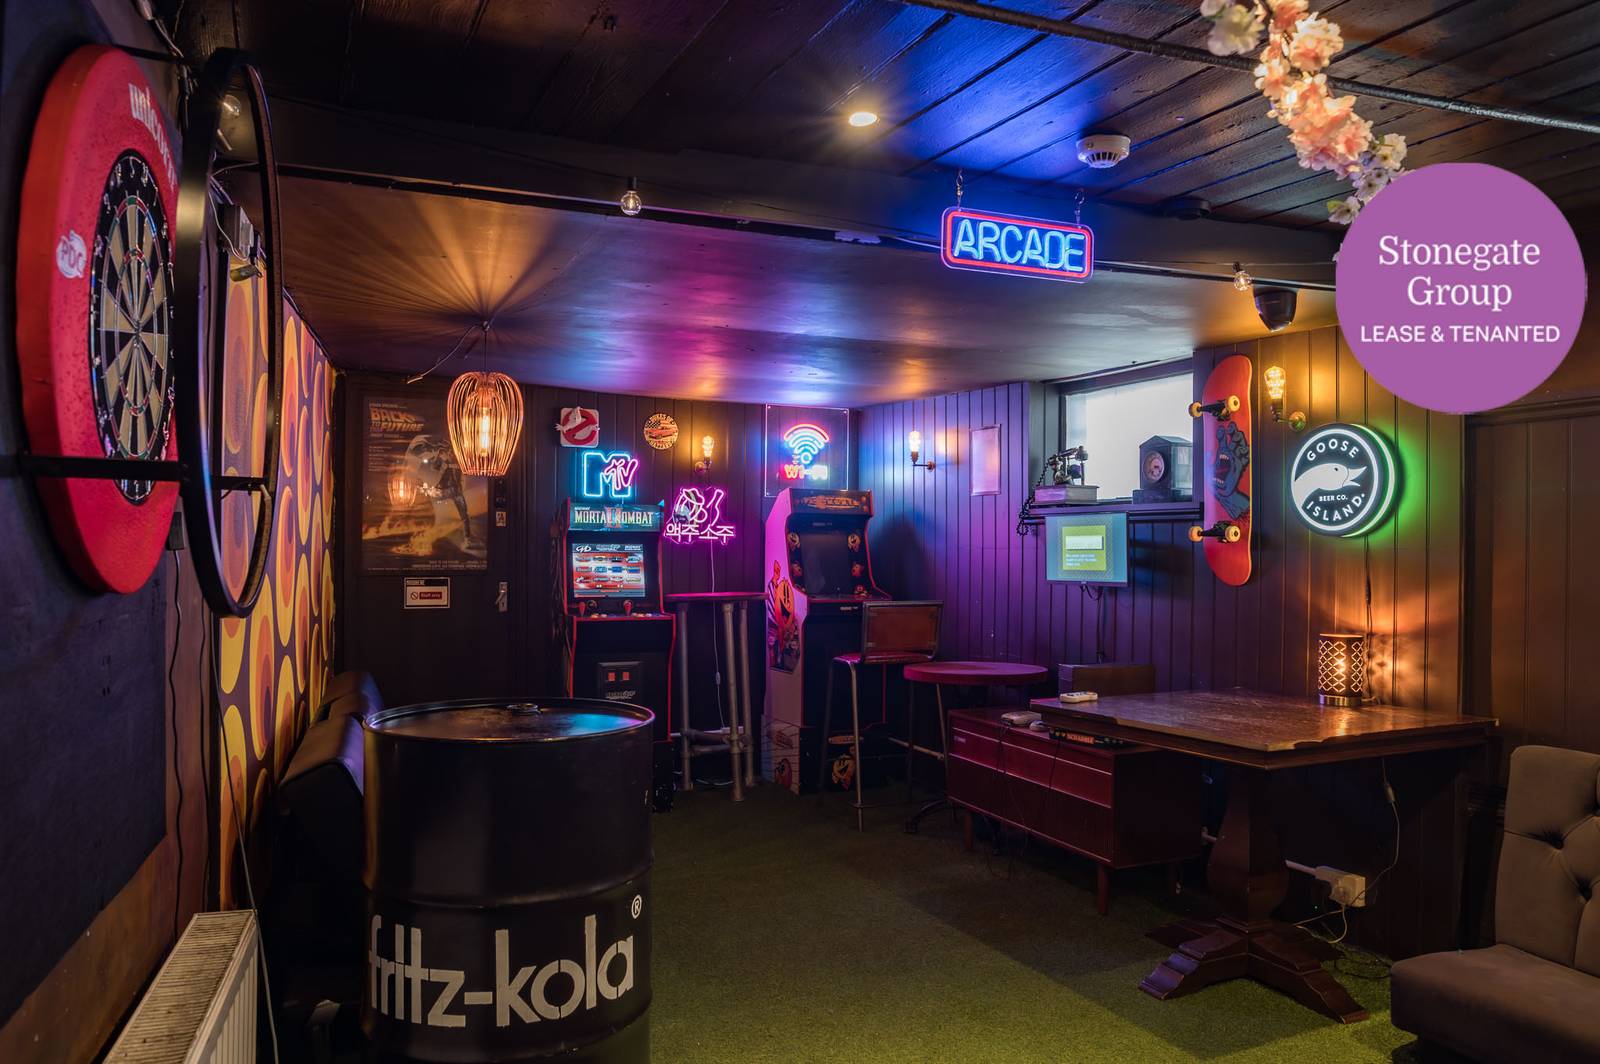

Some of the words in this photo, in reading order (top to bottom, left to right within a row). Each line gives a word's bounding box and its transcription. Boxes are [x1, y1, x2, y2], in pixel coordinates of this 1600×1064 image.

[954, 219, 1085, 272] ARCADE
[381, 422, 425, 433] FUTURE
[1306, 438, 1360, 461] GOOSE
[583, 452, 639, 497] MTV
[1306, 495, 1363, 521] ISLAND
[1318, 494, 1335, 502] BEER
[574, 511, 613, 524] MORTAL
[614, 511, 654, 525] KOMBAT
